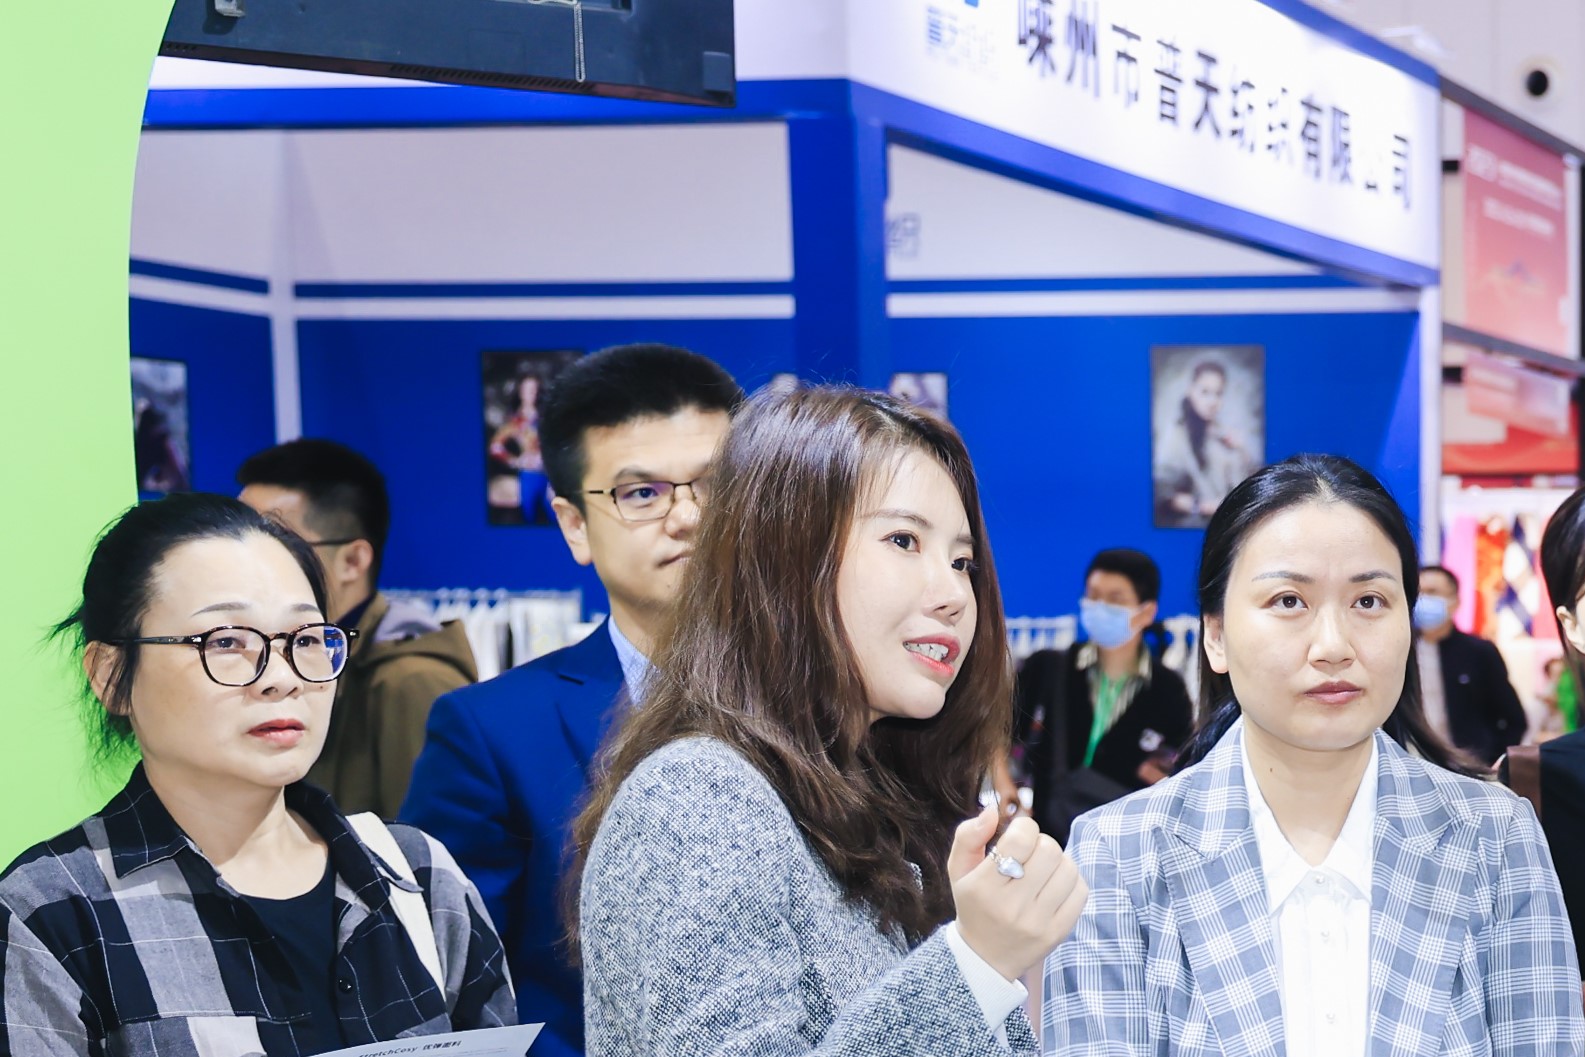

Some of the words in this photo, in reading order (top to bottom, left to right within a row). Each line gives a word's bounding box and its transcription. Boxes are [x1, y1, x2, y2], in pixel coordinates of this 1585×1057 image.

[1018, 0, 1411, 210] 嵊州市普天纺织有限司
